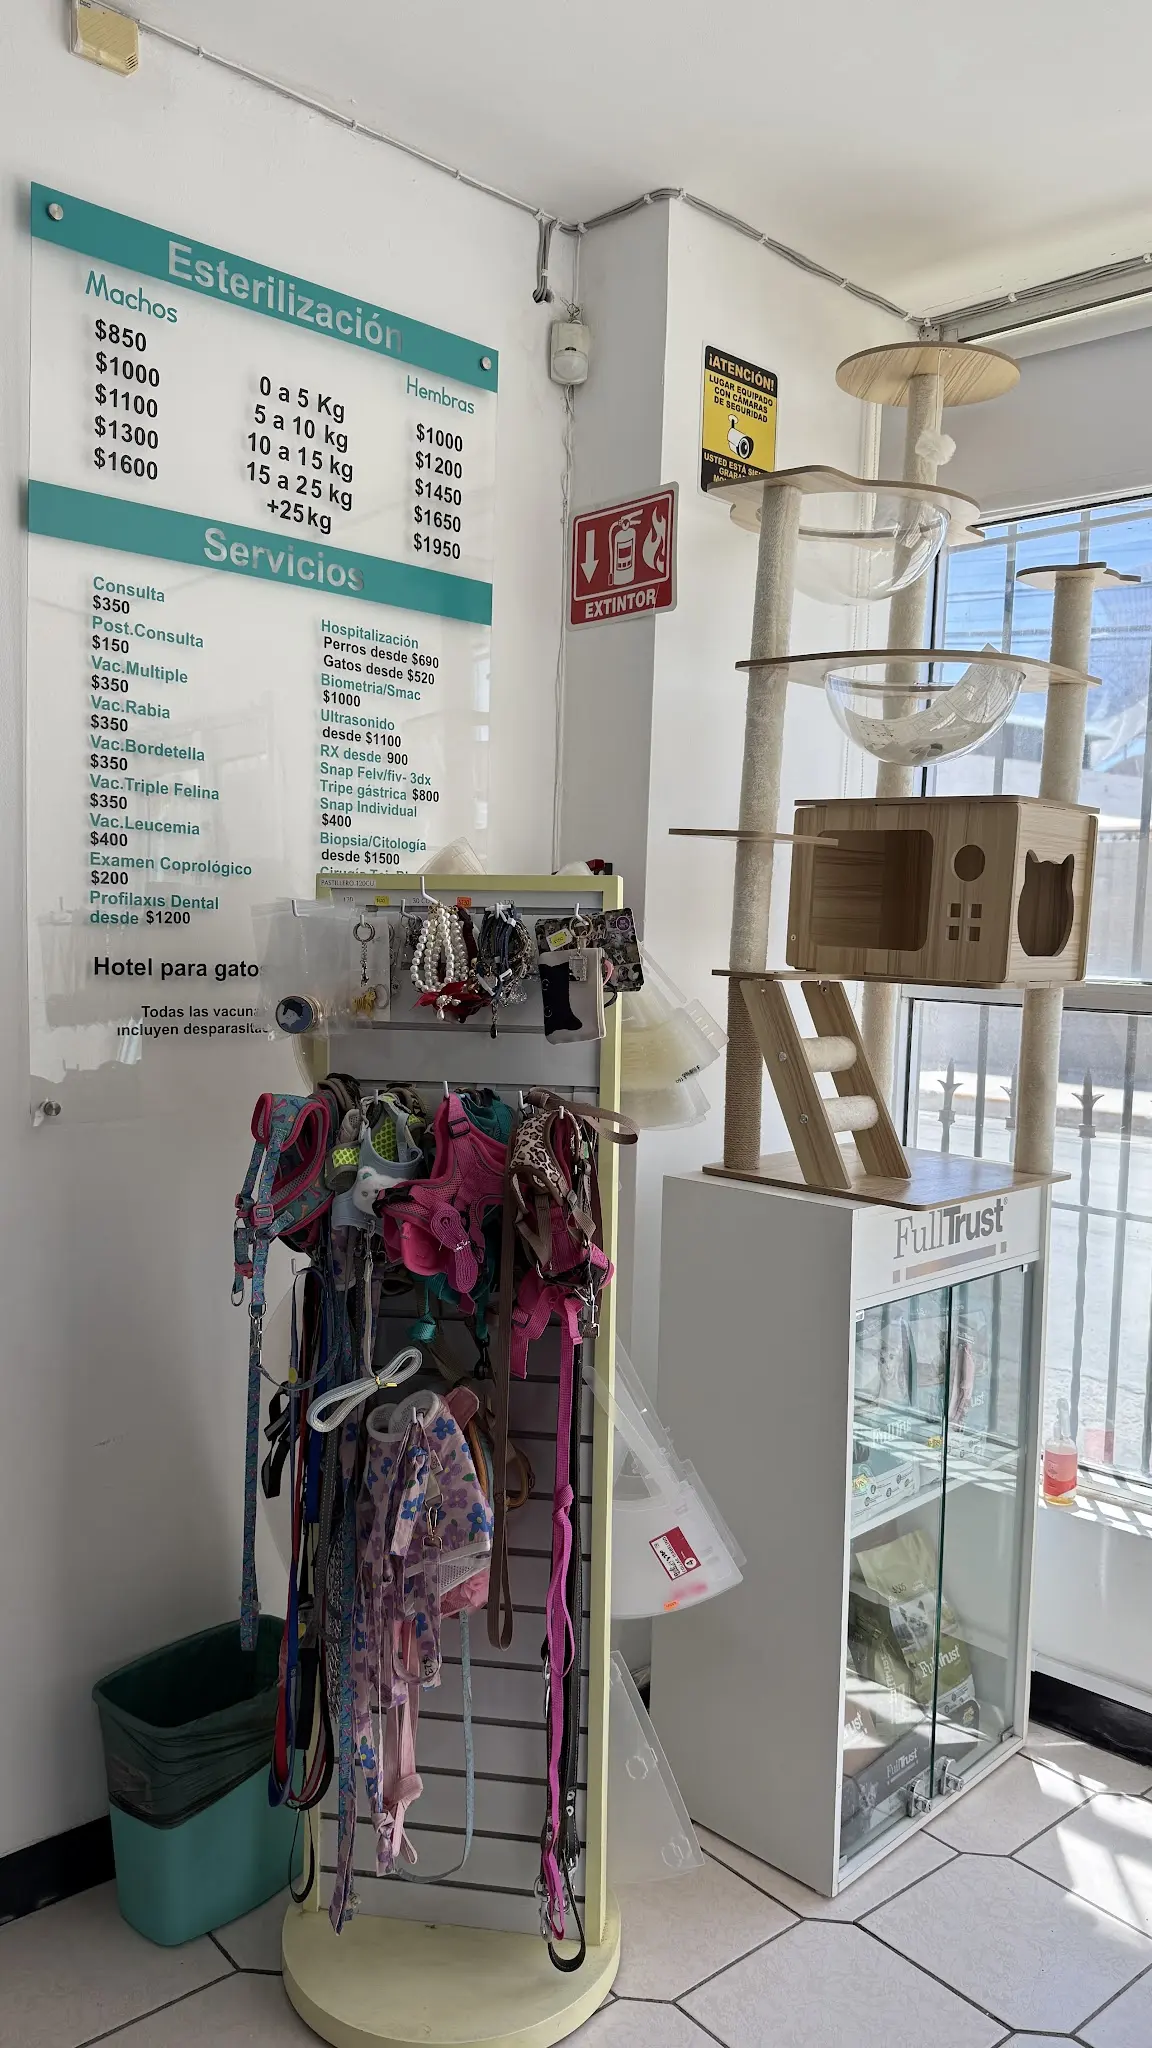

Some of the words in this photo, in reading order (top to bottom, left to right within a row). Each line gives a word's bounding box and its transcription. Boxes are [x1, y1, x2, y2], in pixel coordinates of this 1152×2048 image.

[85, 270, 178, 324] Machos
[168, 240, 403, 352] Esterilización
[94, 318, 147, 352] $850
[95, 350, 160, 388] $1000
[709, 353, 775, 392] ¡ATENCIÓN!
[94, 383, 158, 418] $1100
[259, 376, 271, 397] 0
[278, 387, 290, 404] a
[297, 387, 309, 408] 5
[317, 393, 345, 424] Kg
[407, 375, 475, 415] Hembras
[709, 374, 735, 391] LUGAR
[737, 385, 773, 407] EQUIPADO
[714, 386, 731, 400] CON
[732, 393, 768, 414] CÁMARAS
[714, 396, 725, 407] DE
[726, 401, 768, 423] SEGURIDAD
[94, 414, 159, 450] $1300
[254, 403, 266, 425] 5
[273, 414, 285, 431] a
[292, 416, 316, 439] 10
[324, 424, 348, 454] kg
[416, 422, 463, 453] $1000
[93, 446, 158, 481] $1600
[248, 432, 271, 456] 10
[278, 445, 290, 462] a
[298, 446, 323, 470] 15
[329, 454, 353, 484] kg
[415, 450, 463, 479] $1200
[704, 452, 728, 468] USTED
[728, 460, 747, 475] ESTÁ
[246, 461, 271, 485] 15
[277, 474, 289, 491] a
[295, 475, 322, 499] 25
[329, 483, 353, 512] kg
[415, 477, 462, 506] $1450
[414, 504, 461, 533] $1650
[204, 528, 364, 592] Servicios
[413, 532, 461, 560] $1950
[93, 576, 165, 603] Consulta
[585, 588, 656, 619] EXTINTOR
[92, 594, 130, 615] $350
[91, 615, 204, 648] Post.Consulta
[91, 634, 130, 654] $150
[321, 619, 419, 650] Hospitalización
[324, 636, 367, 656] Perros
[370, 645, 408, 664] desde
[411, 652, 439, 669] $690
[91, 655, 188, 684] Vac.Multiple
[91, 674, 129, 693] $350
[323, 654, 362, 673] Gatos
[365, 662, 404, 680] desde
[407, 668, 435, 685] $520
[321, 670, 421, 701] Biometria/Smac
[323, 689, 361, 708] $1000
[90, 694, 170, 719] Vac.Rabia
[321, 708, 395, 731] Ultrasonido
[90, 713, 128, 732] $350
[90, 734, 205, 762] Vac.Bordetella
[322, 726, 362, 743] desde
[365, 731, 402, 748] $1100
[89, 753, 128, 771] $350
[320, 744, 340, 759] RX
[343, 747, 382, 764] desde
[387, 752, 408, 766] 900
[89, 773, 169, 797] Vac.Triple
[174, 782, 219, 801] Felina
[320, 762, 354, 780] Snap
[410, 772, 431, 786] 3dx
[89, 792, 128, 810] $350
[319, 779, 353, 797] Tripe
[357, 784, 407, 803] gástrica
[412, 788, 440, 803] $800
[320, 797, 354, 815] Snap
[357, 800, 417, 818] Individual
[321, 812, 352, 828] $400
[89, 812, 200, 836] Vac.Leucemia
[90, 830, 128, 847] $400
[320, 831, 427, 853] Biopsia/Citología
[90, 851, 155, 870] Examen
[160, 856, 252, 878] Coprológico
[321, 848, 361, 863] desde
[364, 850, 400, 865] $1500
[90, 869, 129, 886] $200
[90, 890, 167, 909] Profilaxis
[173, 894, 219, 912] Dental
[89, 910, 139, 927] desde
[145, 908, 191, 926] $1200
[94, 956, 153, 976] Hotel
[161, 962, 208, 981] para
[214, 960, 263, 982] gato
[141, 1005, 185, 1020] Todas
[189, 1005, 209, 1021] las
[213, 1008, 260, 1021] vacun
[117, 1023, 179, 1039] incluyen
[893, 1198, 1004, 1260] FullTrust
